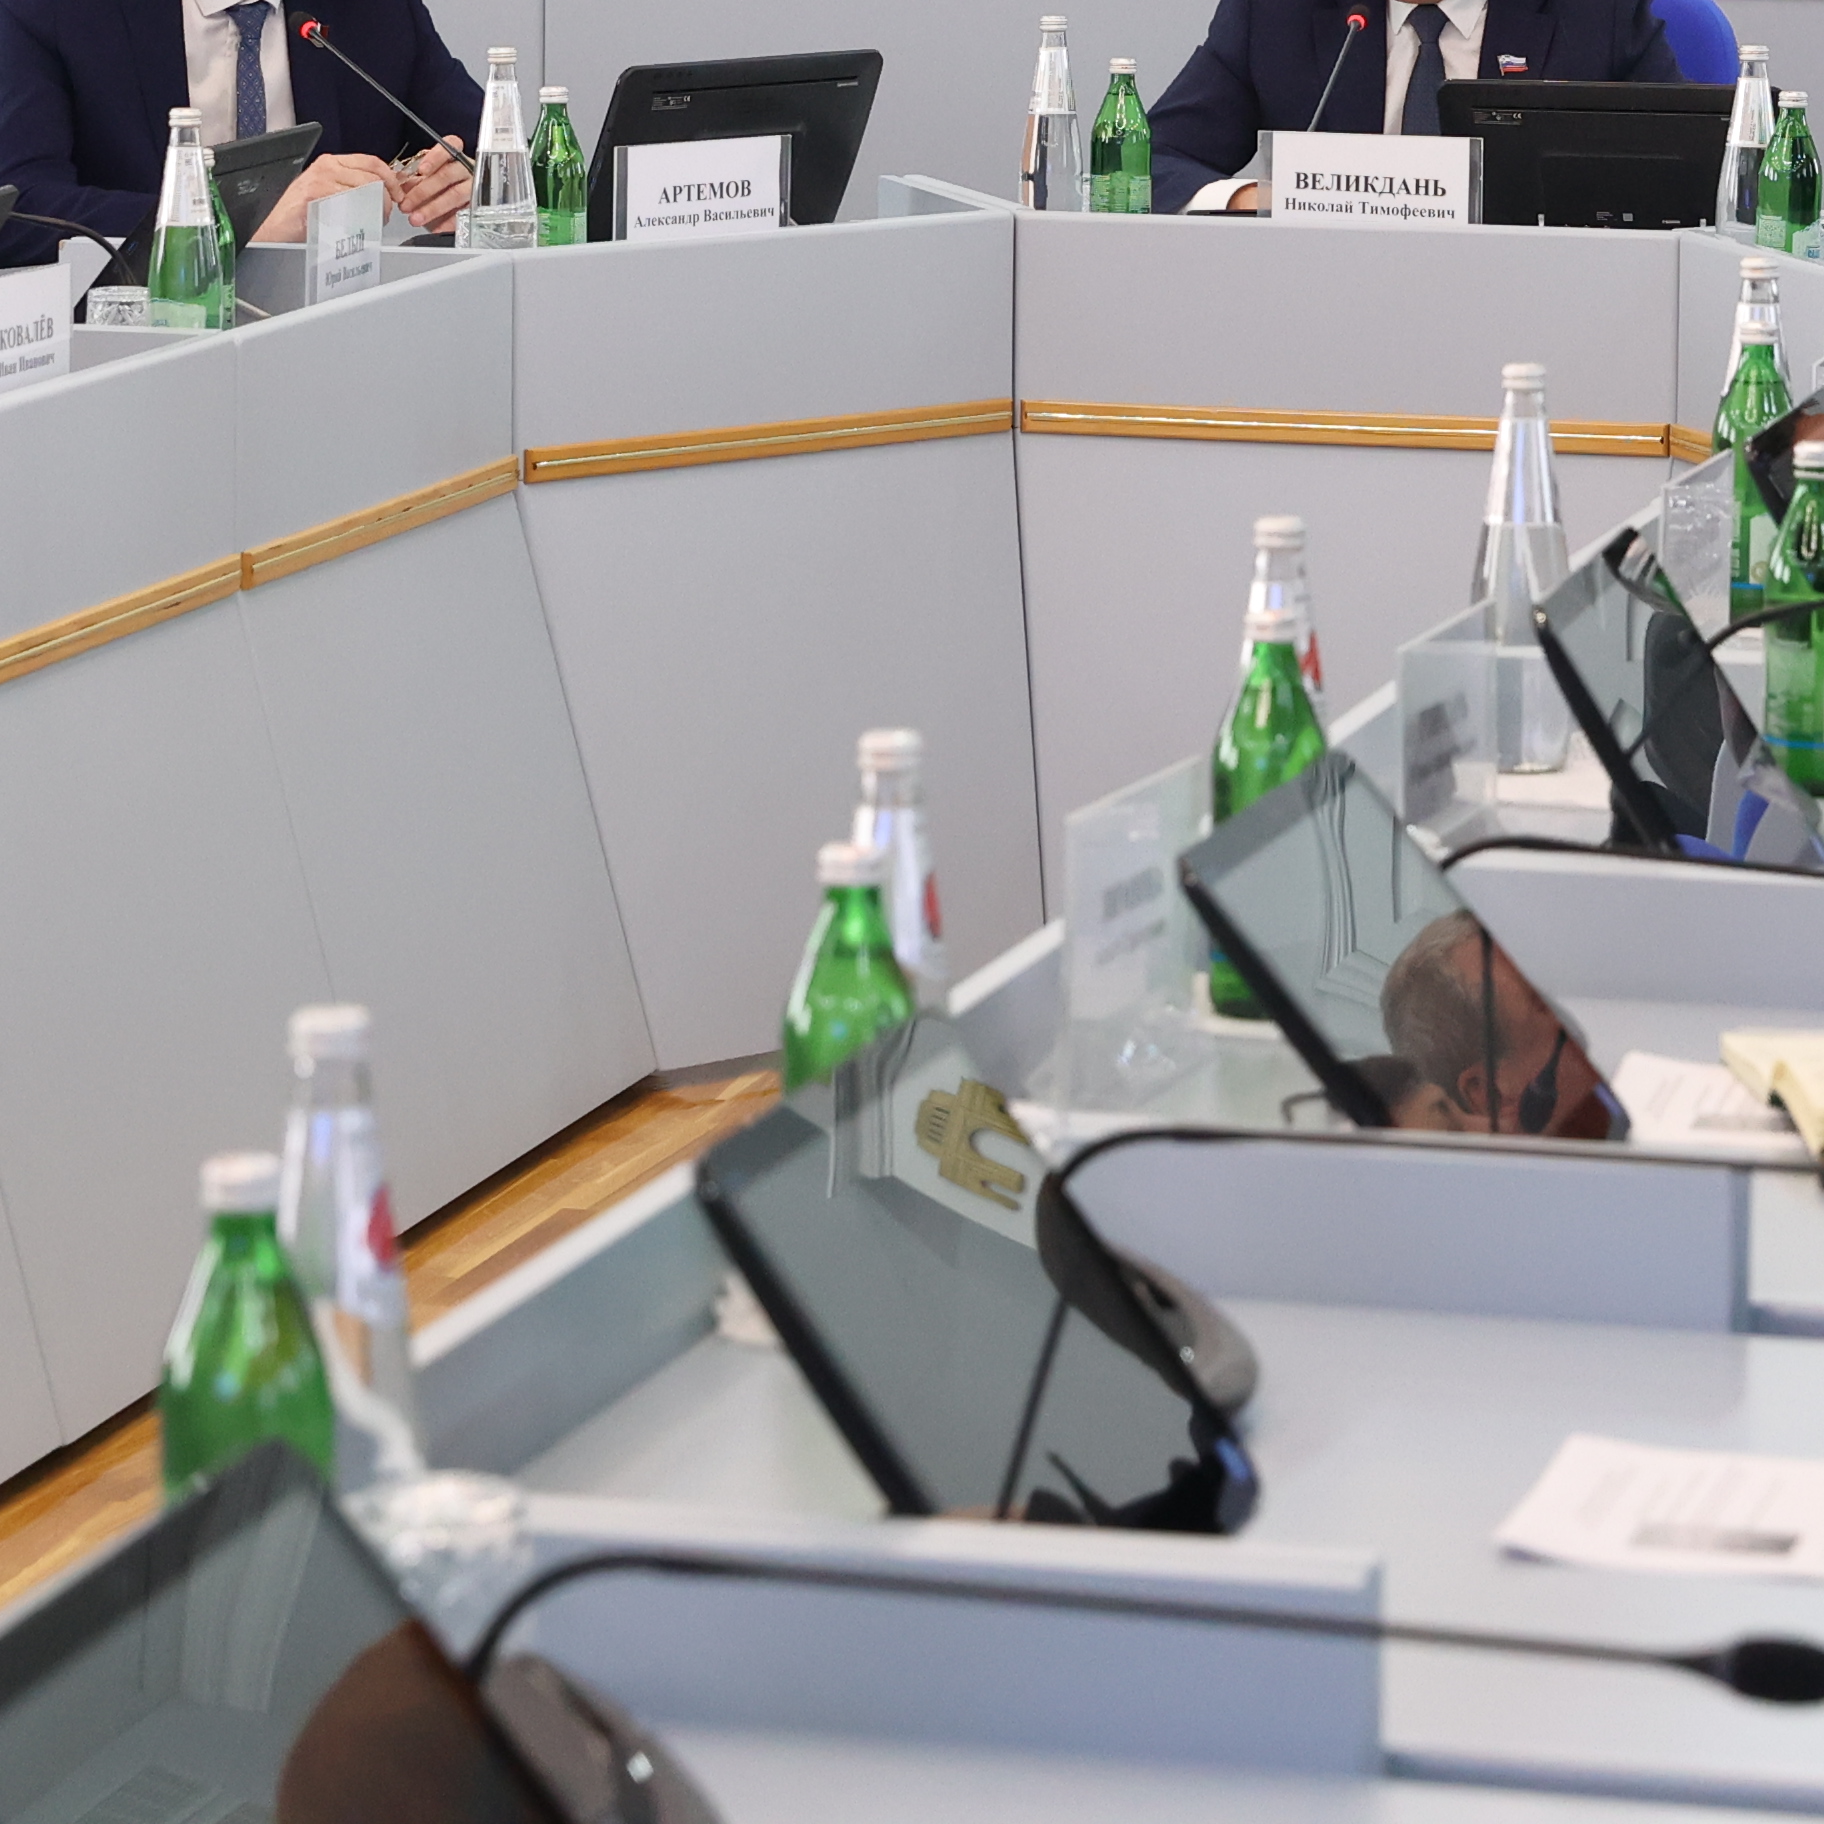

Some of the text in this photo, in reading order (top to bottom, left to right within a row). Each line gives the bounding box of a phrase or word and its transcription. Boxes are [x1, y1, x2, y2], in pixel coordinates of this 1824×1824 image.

[658, 179, 752, 205] АРТЕМОВ
[1295, 171, 1447, 198] ВЕЛИКДАНЬ
[634, 205, 775, 229] Александр Васильевич
[1284, 197, 1456, 220] Николай Тимофеевич
[0, 314, 54, 351] КОВАЛЁВ
[19, 352, 55, 373] Иванович
